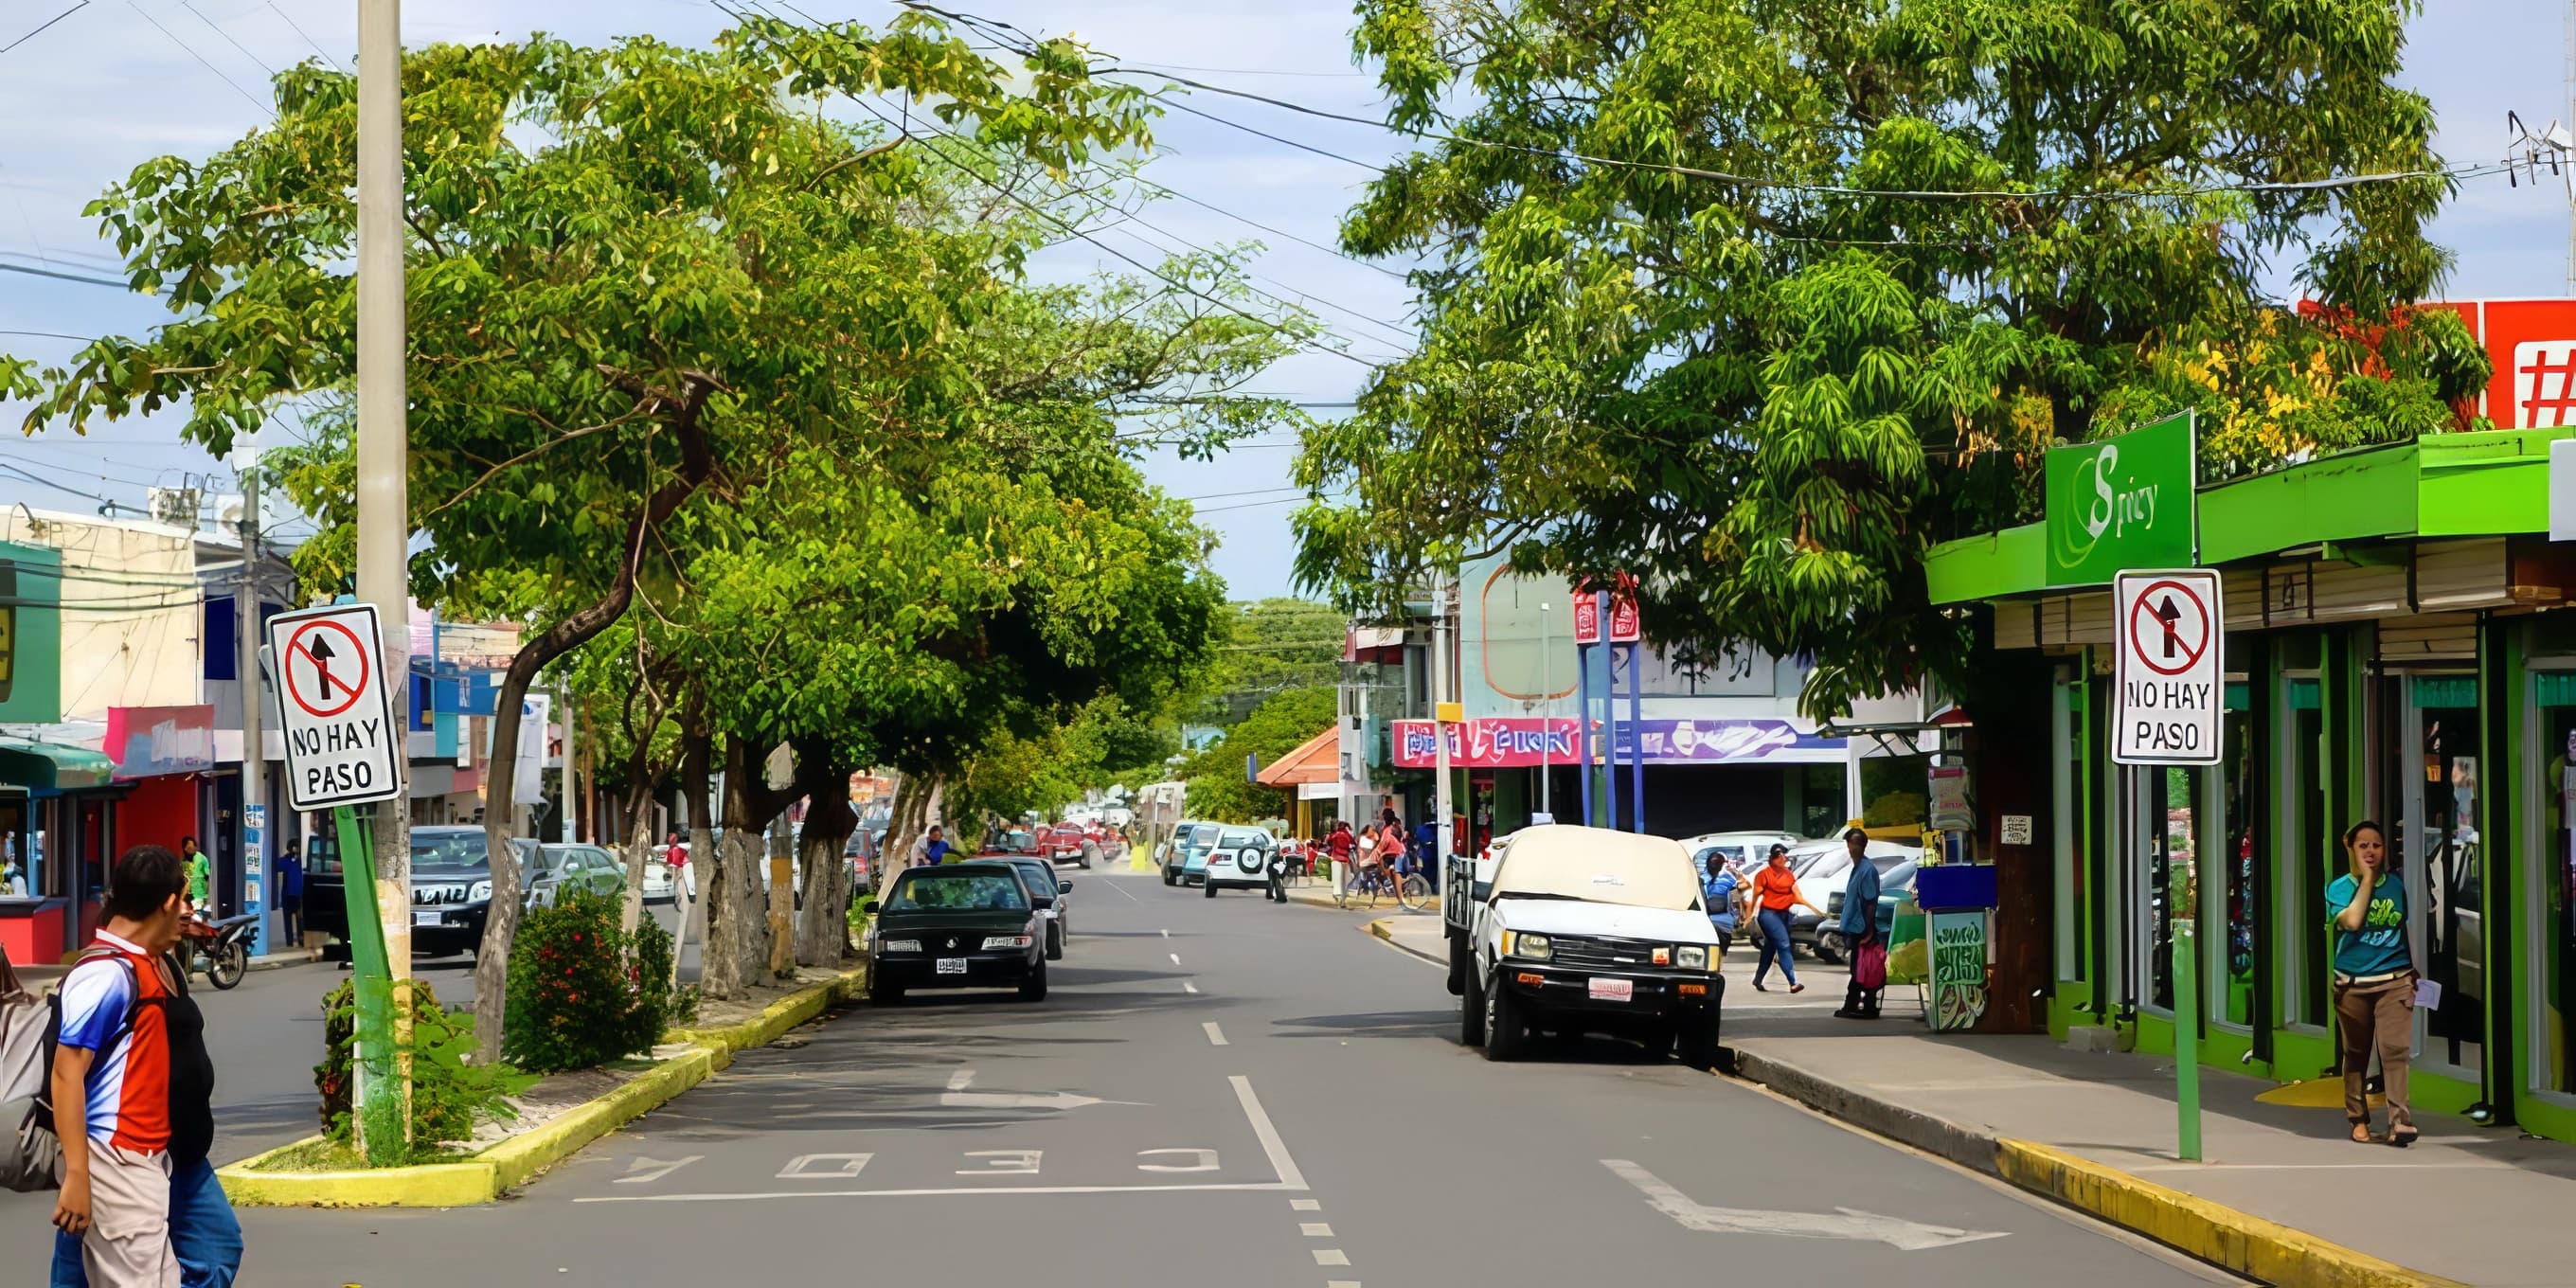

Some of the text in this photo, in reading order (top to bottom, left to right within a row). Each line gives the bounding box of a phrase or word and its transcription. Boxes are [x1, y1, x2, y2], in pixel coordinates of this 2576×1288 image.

[2087, 444, 2158, 539] Spicy
[2128, 679, 2210, 710] NO HAY
[293, 717, 379, 757] NO HAY
[2135, 721, 2199, 751] PASO
[307, 760, 372, 796] PASO
